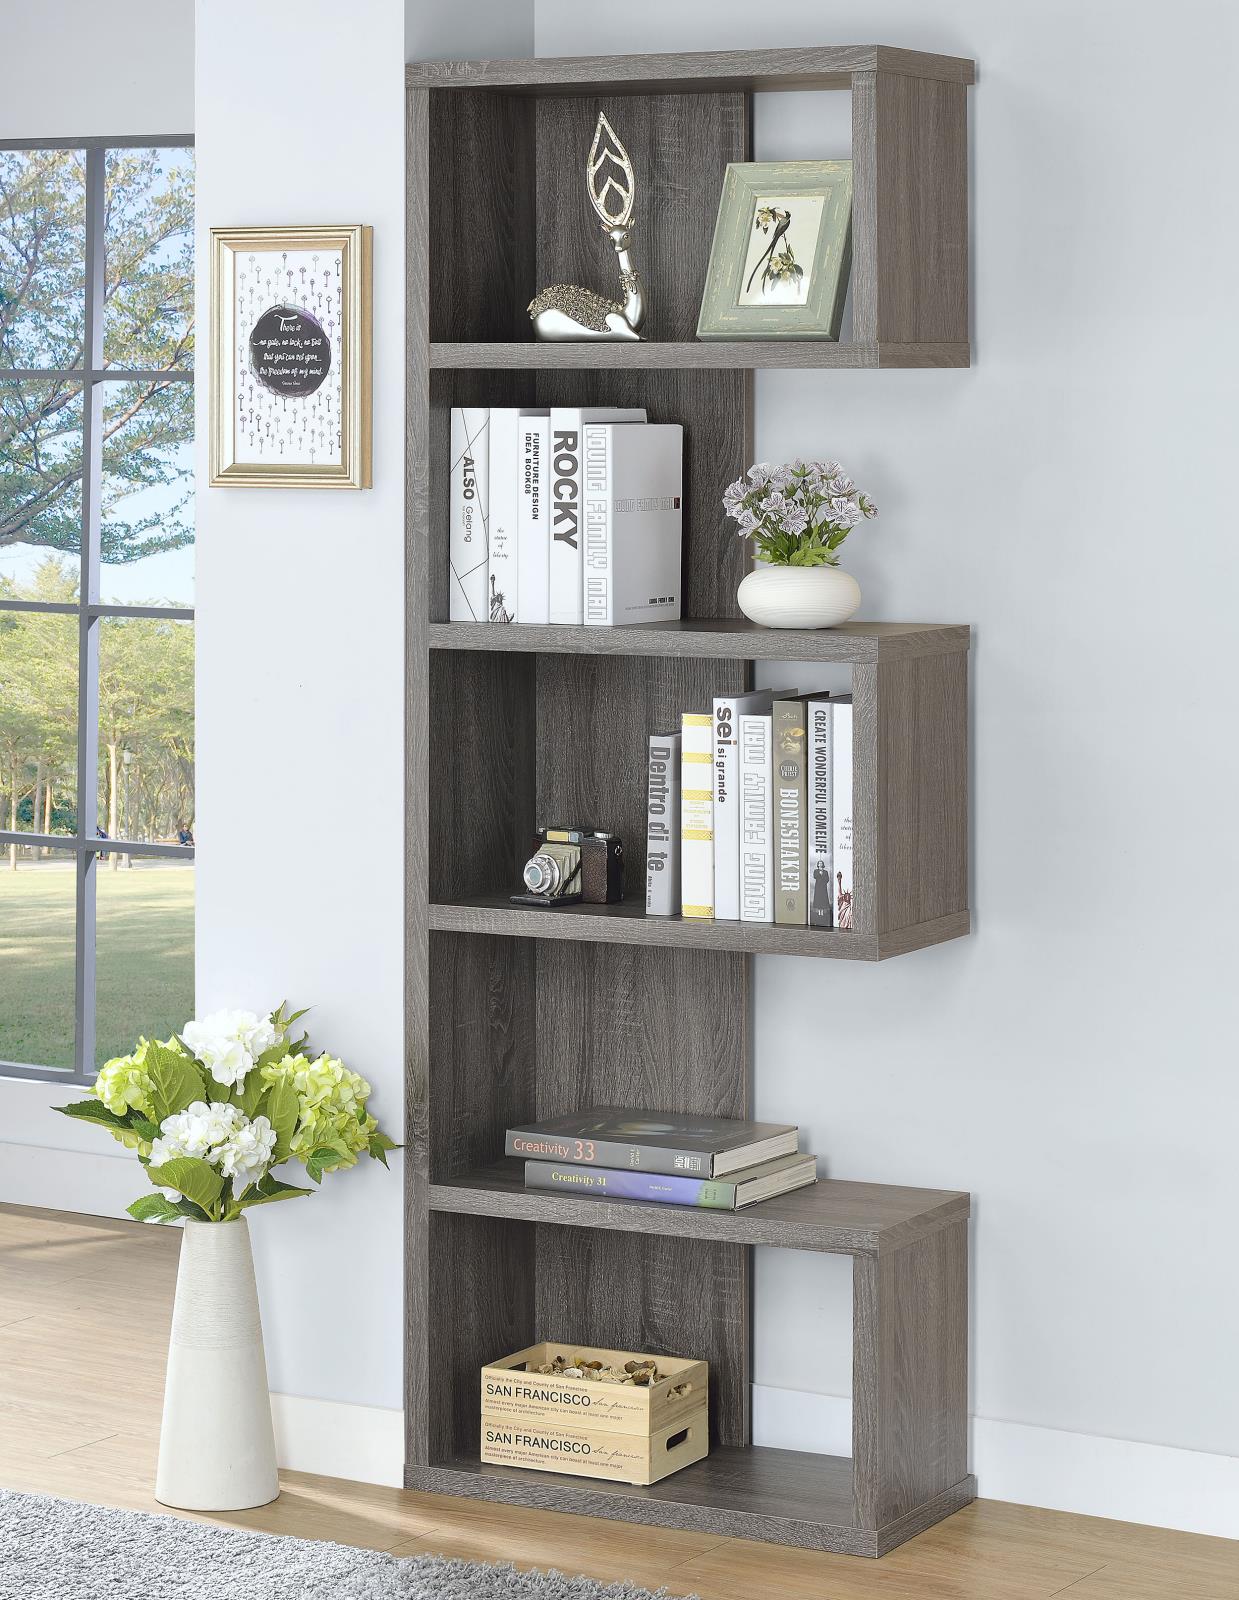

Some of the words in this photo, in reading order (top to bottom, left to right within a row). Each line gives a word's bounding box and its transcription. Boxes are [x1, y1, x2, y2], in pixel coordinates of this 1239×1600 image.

[274, 314, 298, 332] There
[260, 367, 268, 376] the
[268, 367, 290, 377] freedom
[290, 367, 298, 377] of
[299, 368, 308, 378] my
[263, 352, 274, 360] that
[463, 456, 475, 500] ALSO
[532, 432, 540, 484] FURNITURE
[553, 430, 578, 550] ROCKY
[463, 506, 474, 543] Gelang
[586, 499, 608, 569] FAMILY
[587, 578, 608, 620] MAN
[716, 706, 737, 746] sei
[743, 721, 765, 765] MAN
[814, 710, 827, 743] CREATE
[717, 748, 726, 758] si
[648, 746, 670, 815] Dentro
[716, 762, 728, 803] grande
[814, 746, 827, 804] WONDERFUL
[744, 773, 765, 844] FAMILY
[648, 822, 669, 842] di
[779, 788, 800, 892] BONESHAKER
[814, 807, 827, 854] HOMELIFE
[647, 852, 668, 872] te
[514, 1138, 570, 1159] Creativity
[574, 1140, 596, 1161] 33
[552, 1172, 594, 1186] Creativity
[596, 1177, 606, 1186] 31
[486, 1383, 512, 1397] SAN
[515, 1387, 591, 1407] FRANCISCO
[486, 1430, 512, 1444] SAN
[515, 1434, 591, 1455] FRANCISCO
